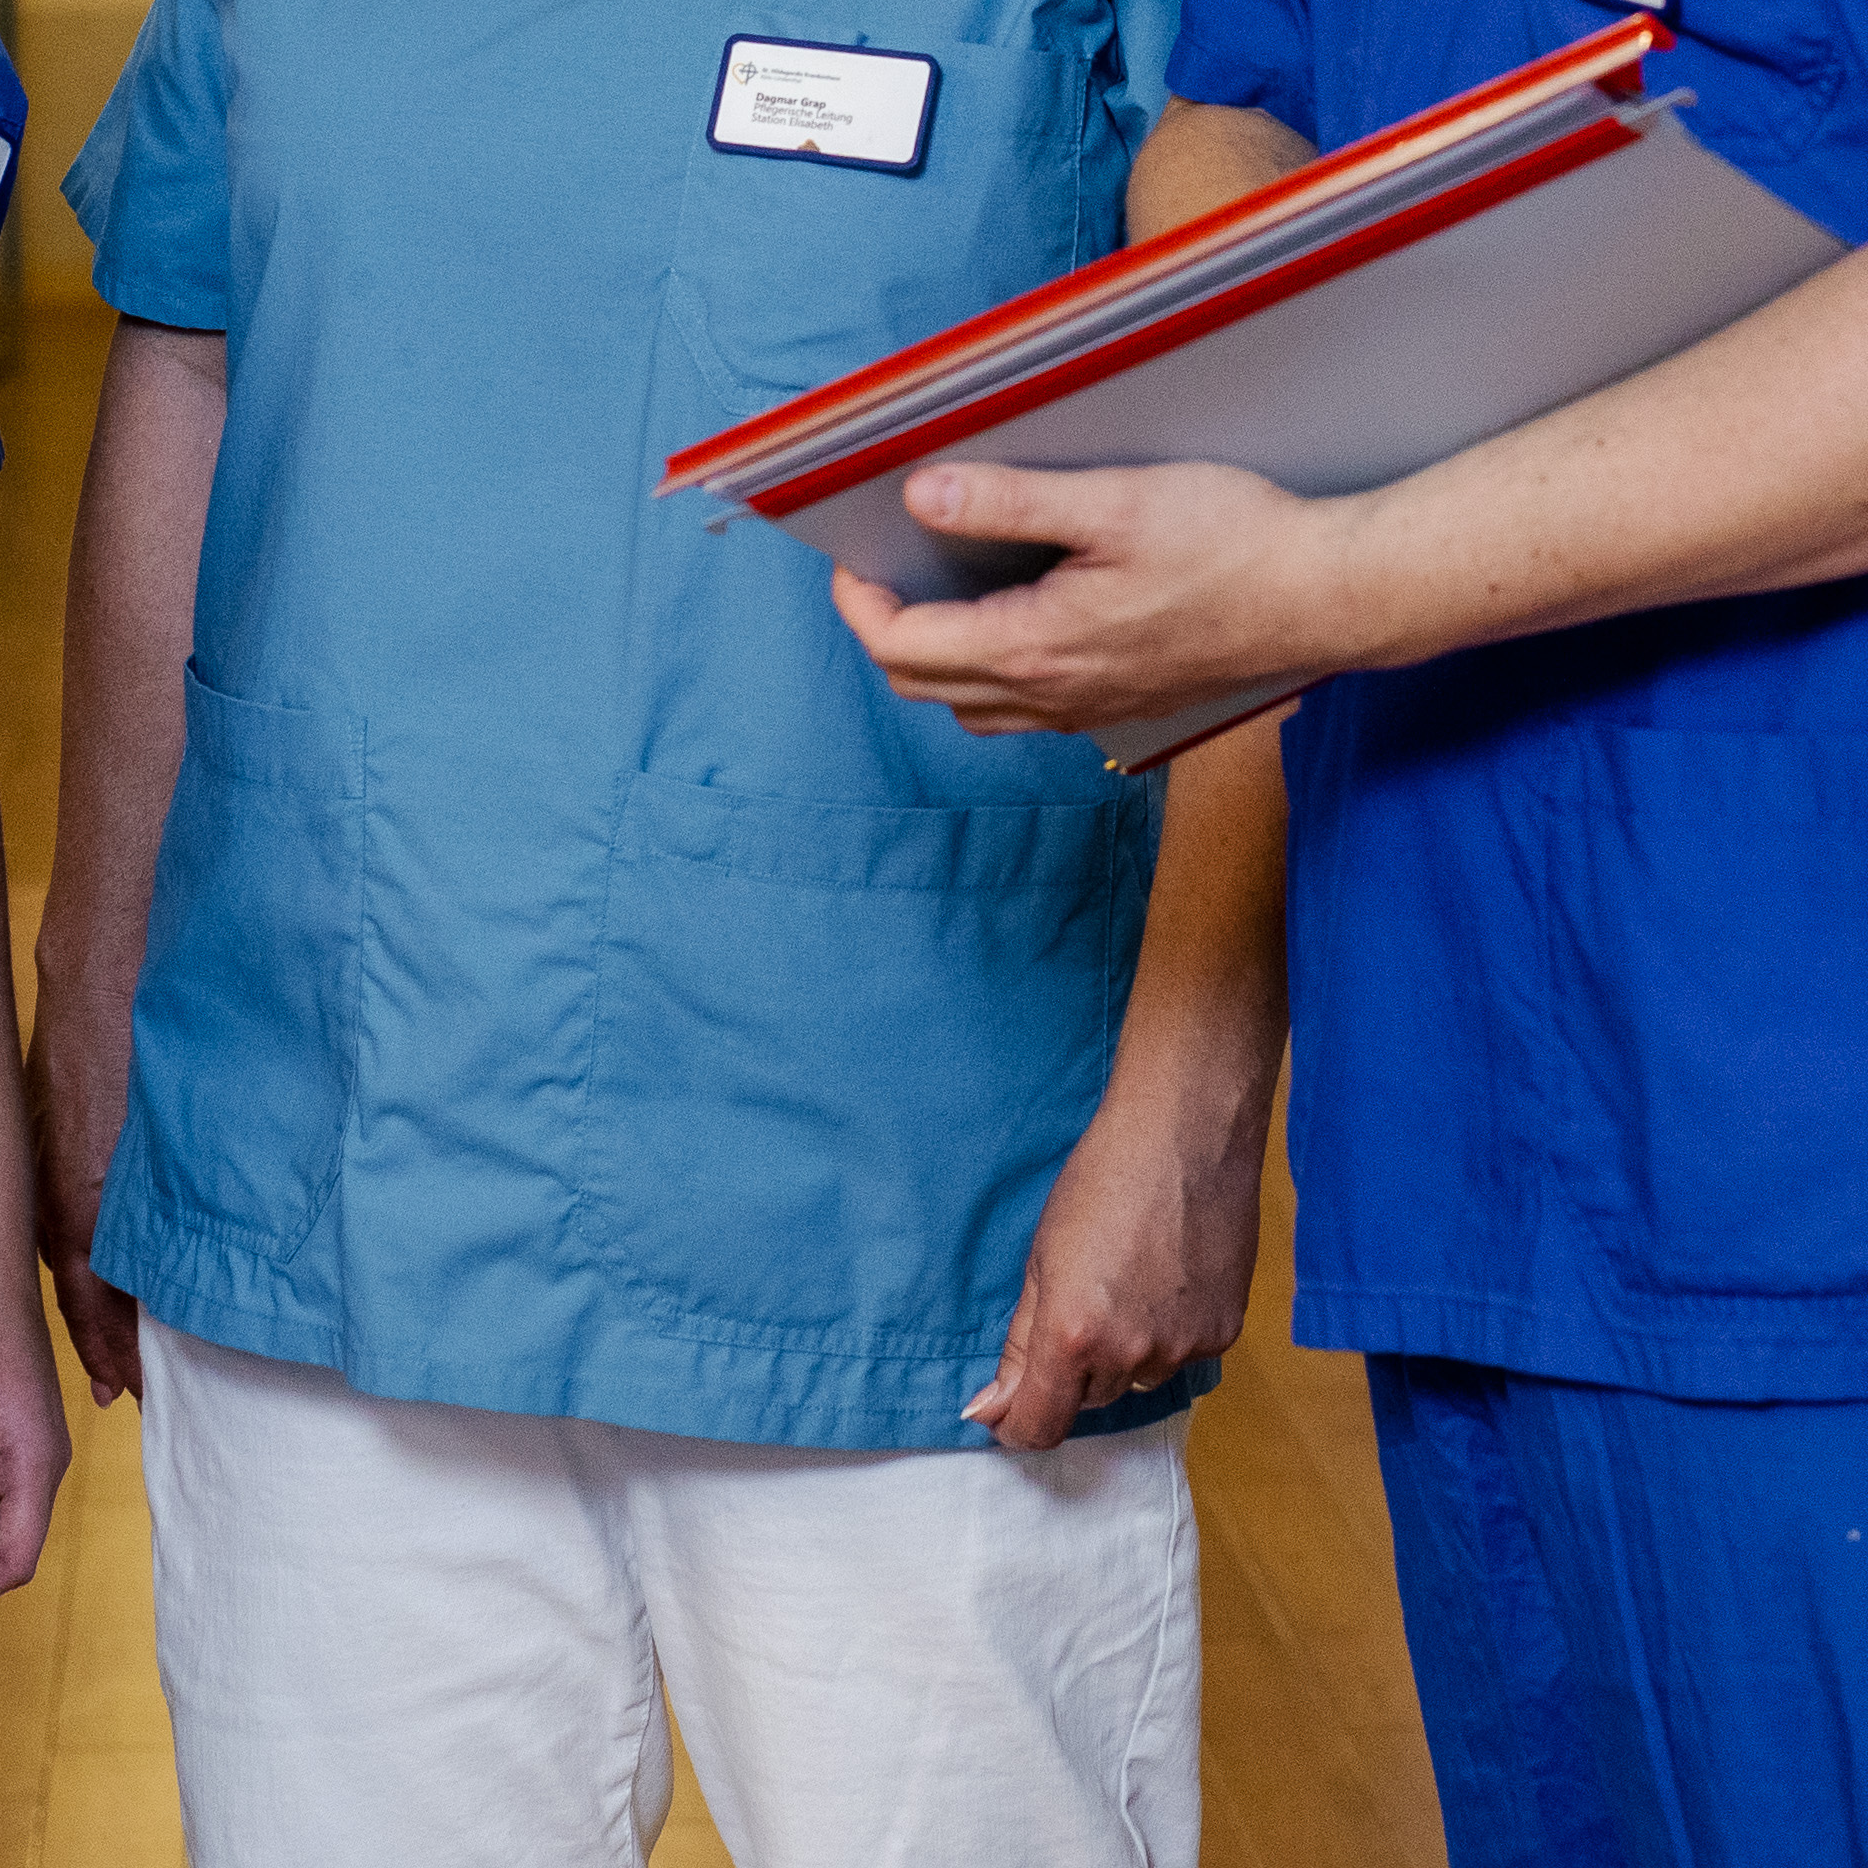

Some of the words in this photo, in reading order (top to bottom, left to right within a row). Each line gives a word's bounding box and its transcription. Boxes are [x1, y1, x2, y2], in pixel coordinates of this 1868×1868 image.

[755, 92, 798, 106] Dagmar
[800, 98, 827, 110] Grap
[751, 113, 787, 126] Station
[788, 117, 834, 131] Elisabeth
[753, 103, 813, 117] Pflegerische
[816, 111, 853, 125] Leitung
